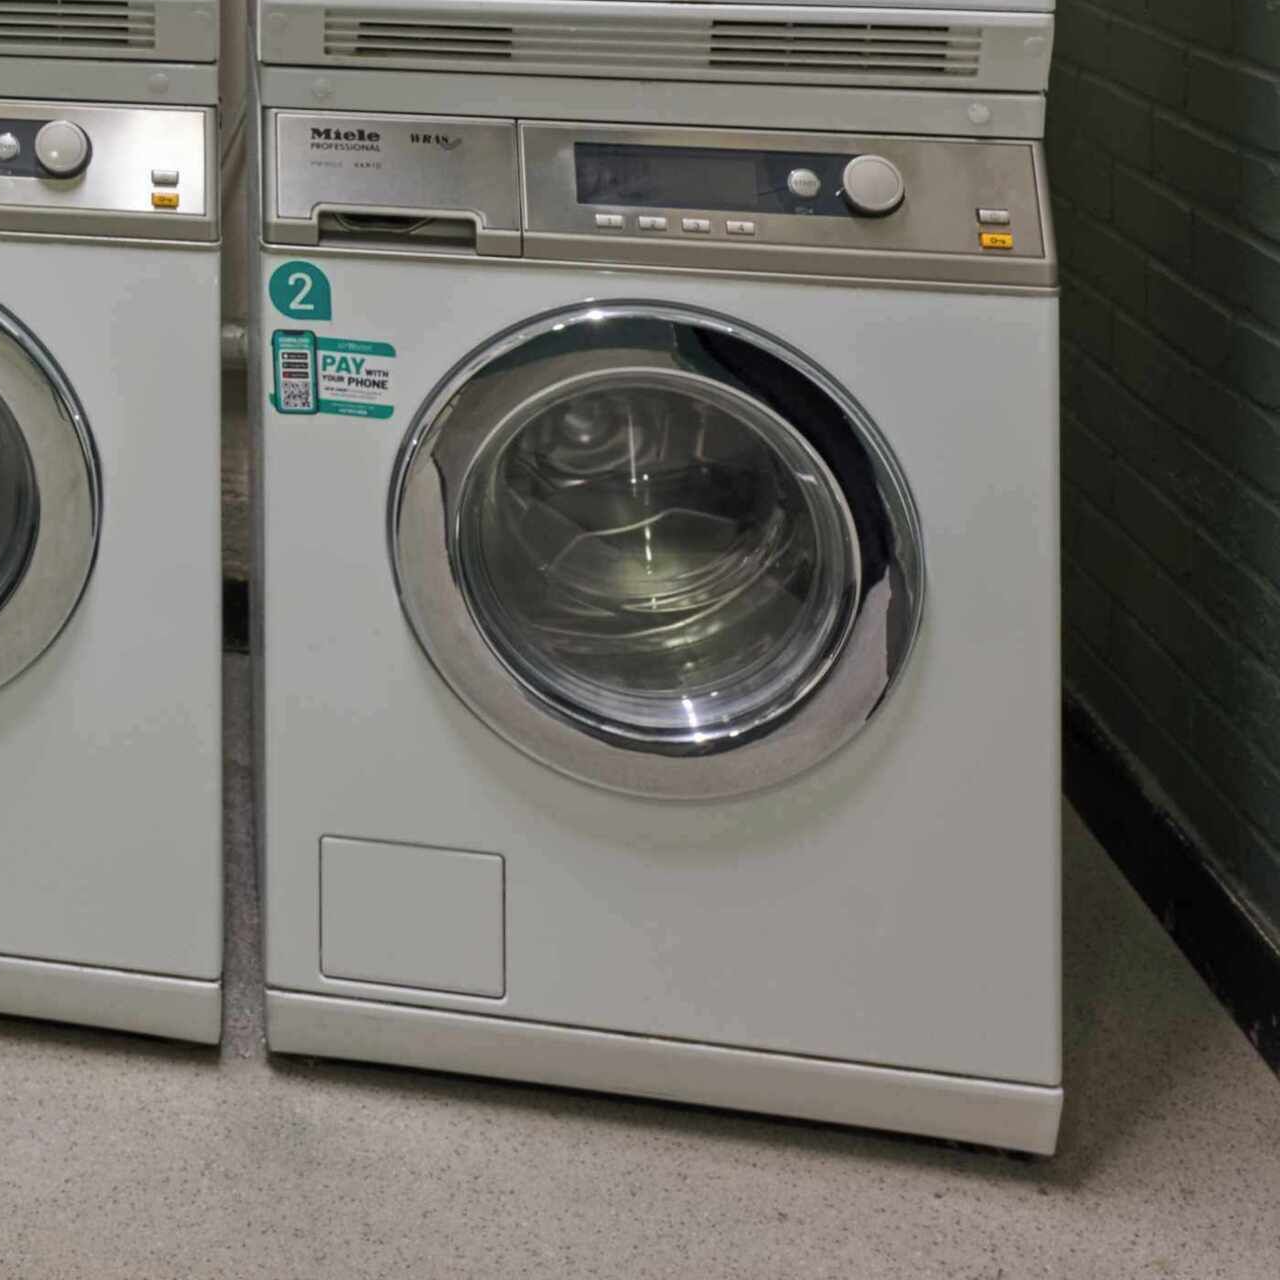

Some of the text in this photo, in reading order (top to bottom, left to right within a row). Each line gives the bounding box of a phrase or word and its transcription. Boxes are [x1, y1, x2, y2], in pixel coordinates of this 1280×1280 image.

[310, 127, 381, 142] Miele
[310, 142, 381, 153] PROFESSIONAL
[288, 272, 314, 310] 2
[321, 355, 366, 375] PAY
[364, 368, 389, 378] WITH
[322, 374, 389, 390] YOUR PHONE
